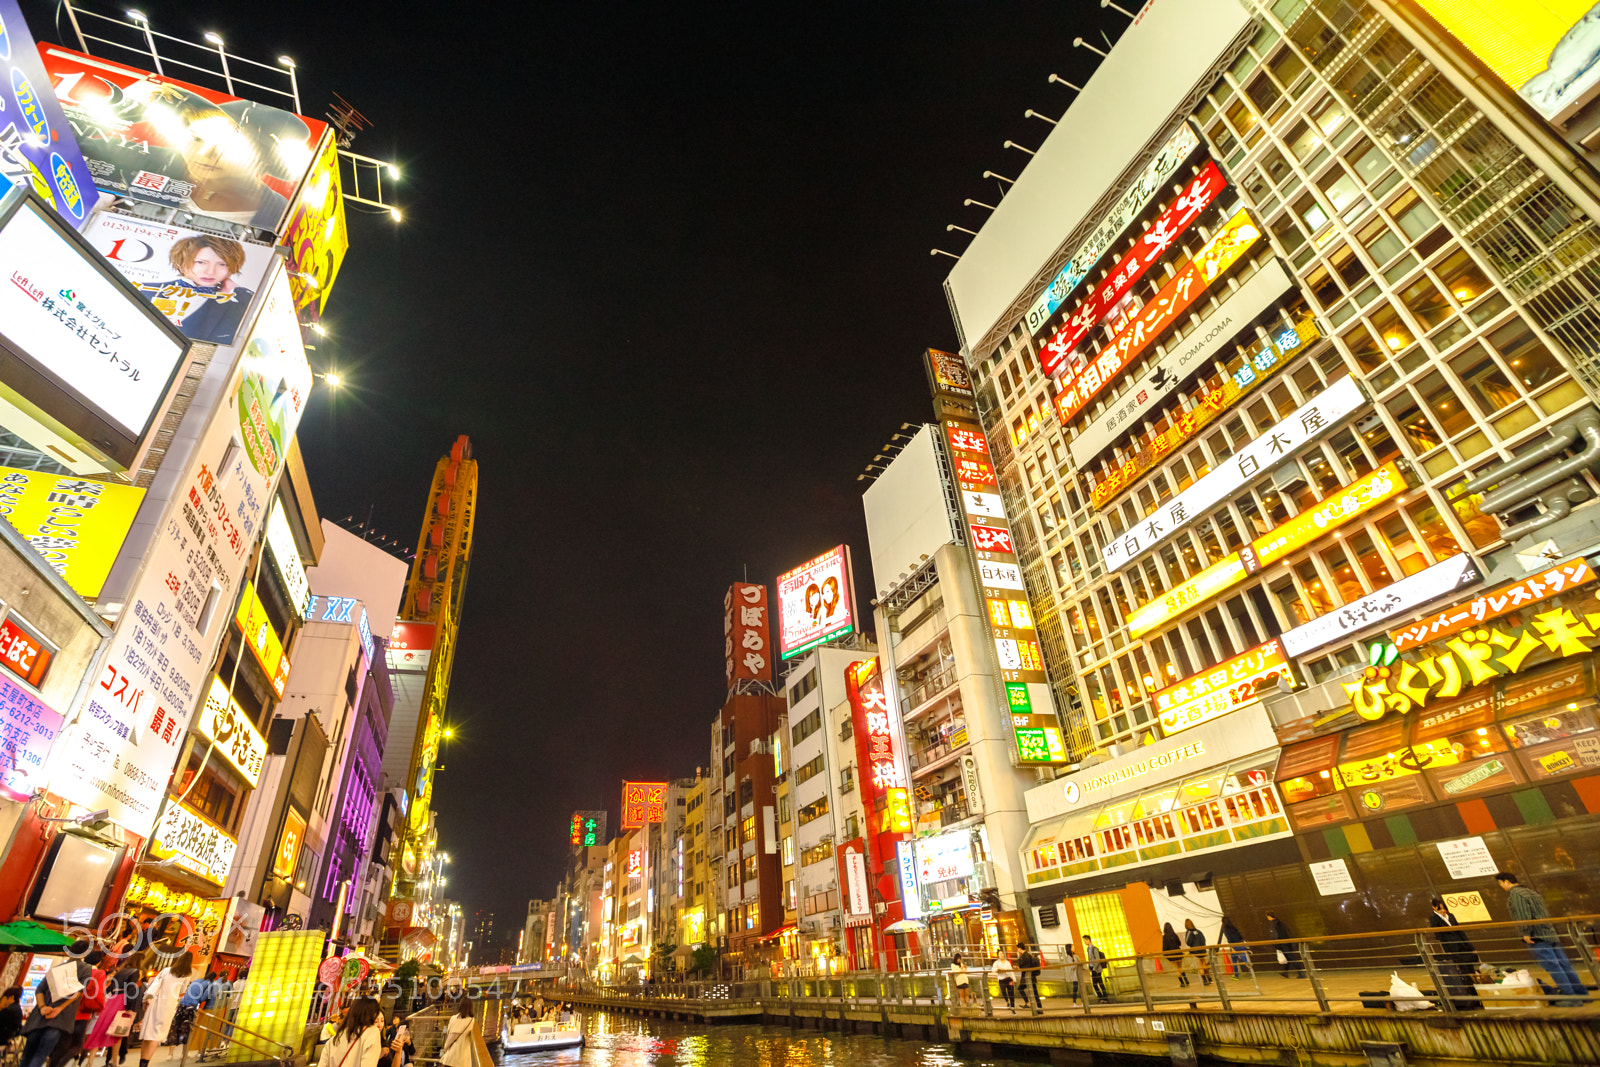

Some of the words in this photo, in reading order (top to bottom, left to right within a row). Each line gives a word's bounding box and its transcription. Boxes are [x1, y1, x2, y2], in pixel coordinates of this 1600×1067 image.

[1102, 258, 1140, 304] 居楽屋
[76, 301, 121, 340] 富士グループ
[1029, 307, 1046, 328] 9F
[42, 297, 141, 382] 株式会社セントラル
[1077, 268, 1194, 399] 相席ダイニング
[1178, 317, 1233, 366] DOMA-DOMA
[947, 420, 960, 429] 8F
[1106, 402, 1137, 432] 居酒家
[1175, 389, 1223, 437] はや
[954, 450, 967, 458] 7F
[958, 468, 994, 483] ダイニング
[1124, 502, 1190, 557] 白木屋
[1238, 407, 1329, 478] 白木屋
[197, 461, 246, 560] 大阪からひとつ走り!
[976, 517, 987, 525] 5F
[972, 529, 1010, 551] はや
[1107, 544, 1120, 557] 4F
[977, 551, 991, 560] 4F
[783, 571, 816, 596] 高収入
[982, 565, 1018, 583] 白木屋
[1461, 571, 1476, 583] 2F
[986, 589, 1000, 598] 3F
[1395, 563, 1589, 647] ハンバーグレストラン
[155, 601, 173, 625] ロッジ
[180, 633, 203, 664] 3,780円
[740, 585, 766, 675] づぼらや
[994, 629, 1009, 638] 2F
[0, 626, 37, 672] たばこ
[1157, 652, 1265, 711] 豊後高田どり
[1261, 641, 1278, 658] 2F
[101, 664, 144, 713] コスパ
[150, 706, 181, 747] 最高!
[1181, 696, 1228, 725] 酒場
[862, 687, 898, 789] 大阪王将
[1576, 739, 1597, 748] KEEP
[1083, 762, 1147, 793] HONOLULU
[1150, 741, 1206, 770] COFFEE
[1581, 755, 1600, 764] RIGH
[629, 787, 662, 804] かに
[938, 865, 959, 879] 免税
